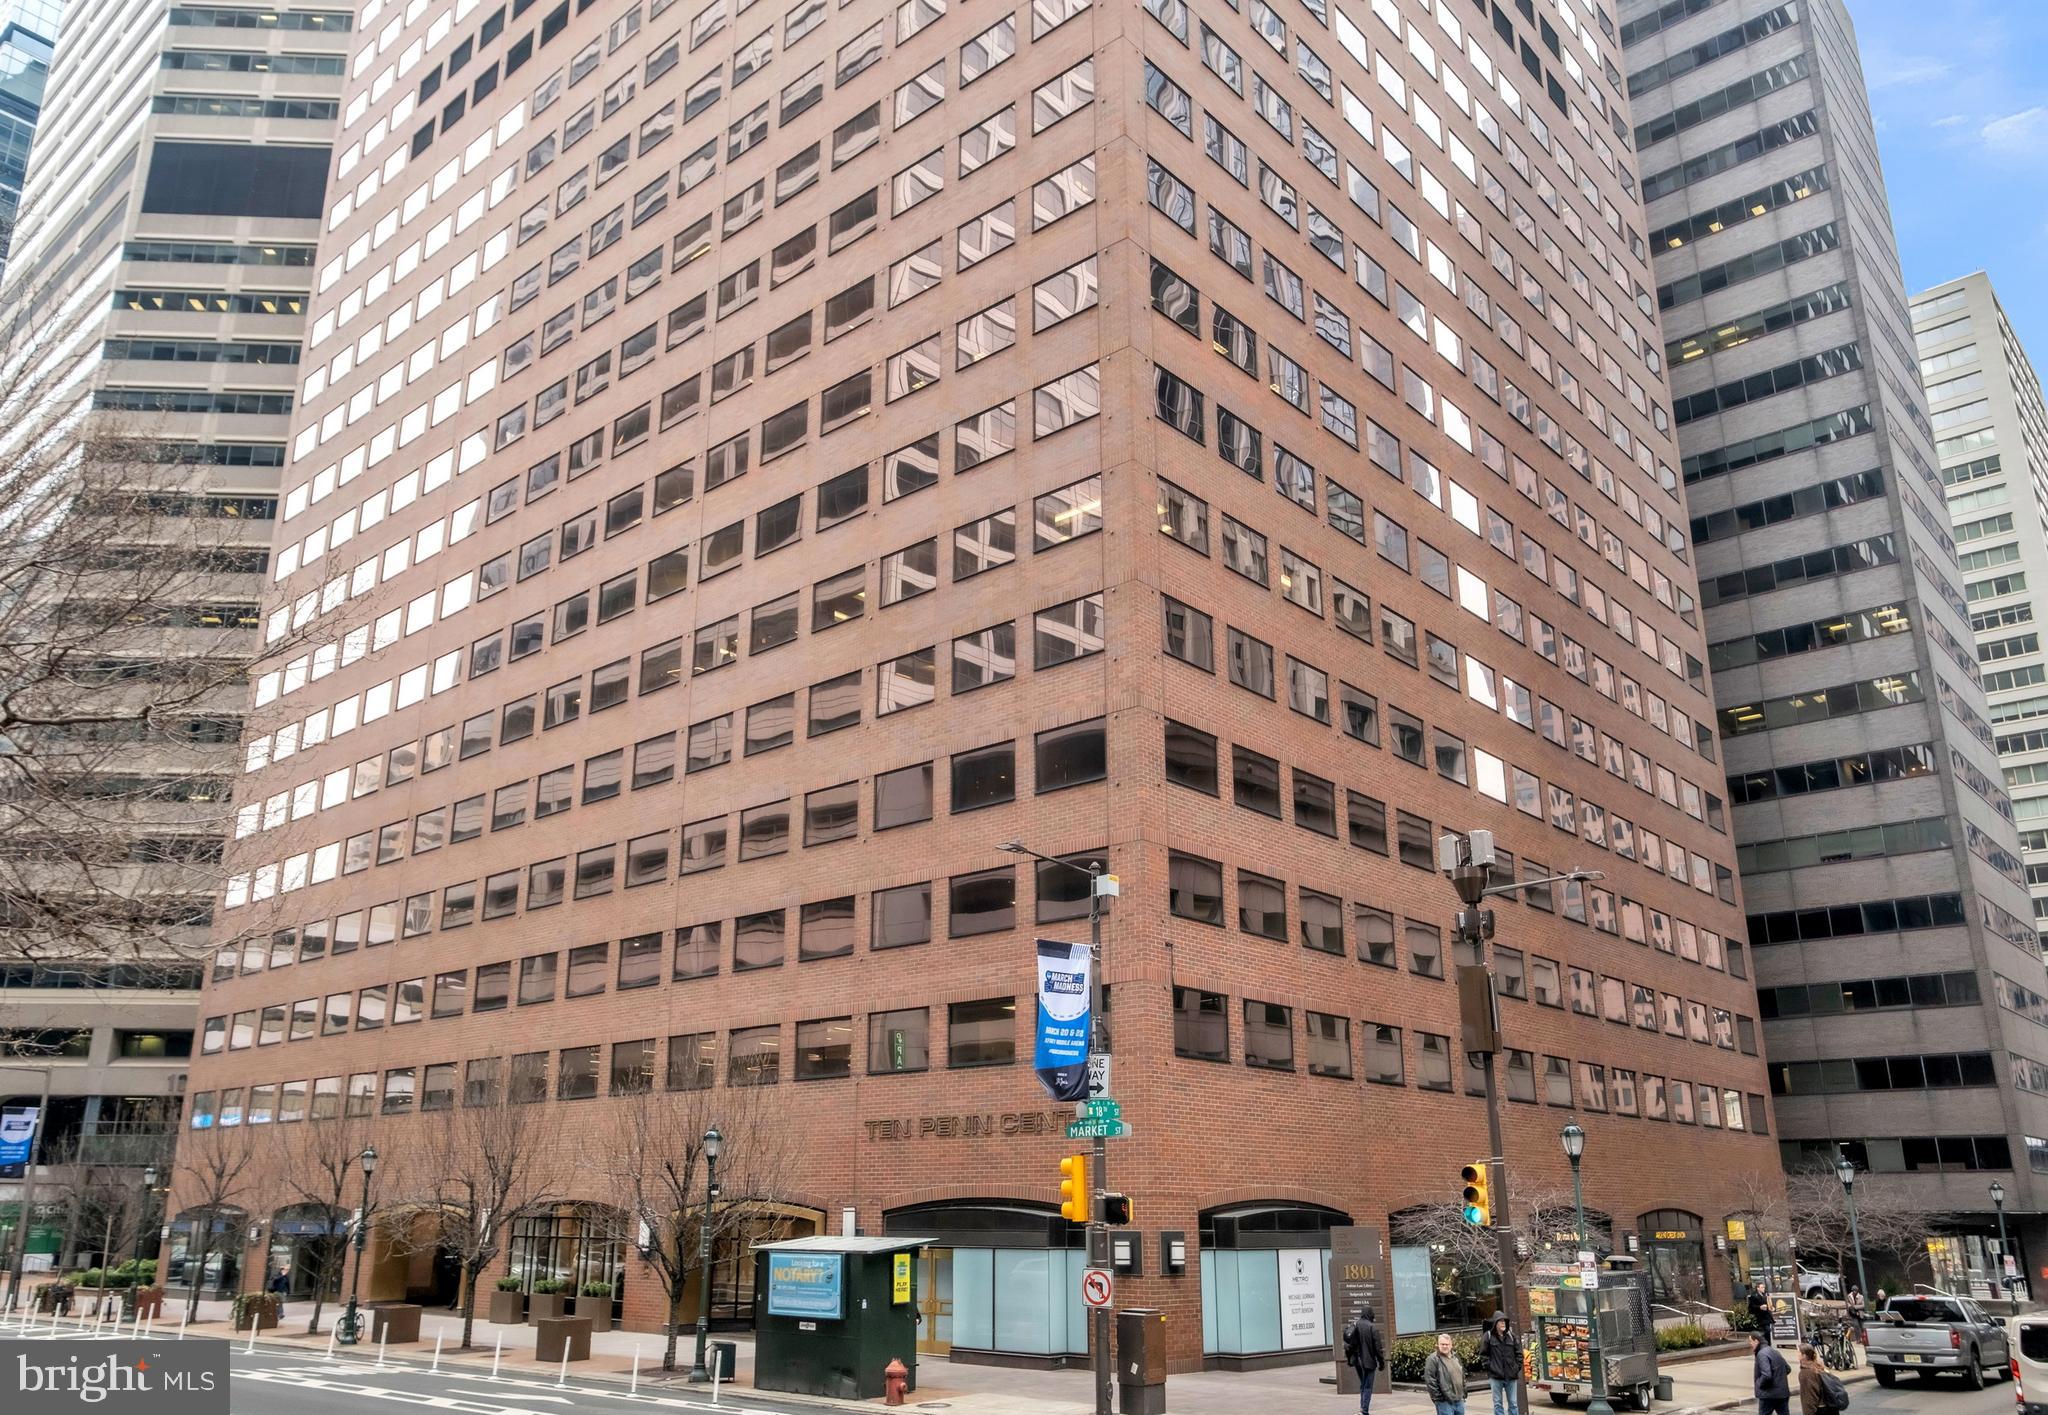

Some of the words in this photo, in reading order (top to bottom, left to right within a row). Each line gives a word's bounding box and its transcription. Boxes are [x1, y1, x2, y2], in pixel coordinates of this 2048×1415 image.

[1051, 972, 1073, 982] MARCH
[1053, 982, 1084, 992] MADNESS
[865, 1117, 911, 1139] TEN
[919, 1113, 992, 1137] PENN
[1001, 1108, 1076, 1134] CENT
[1070, 1124, 1108, 1138] MARKET
[1115, 1126, 1122, 1135] ST
[774, 1266, 824, 1284] NOTARY?
[1343, 1264, 1376, 1280] 1801
